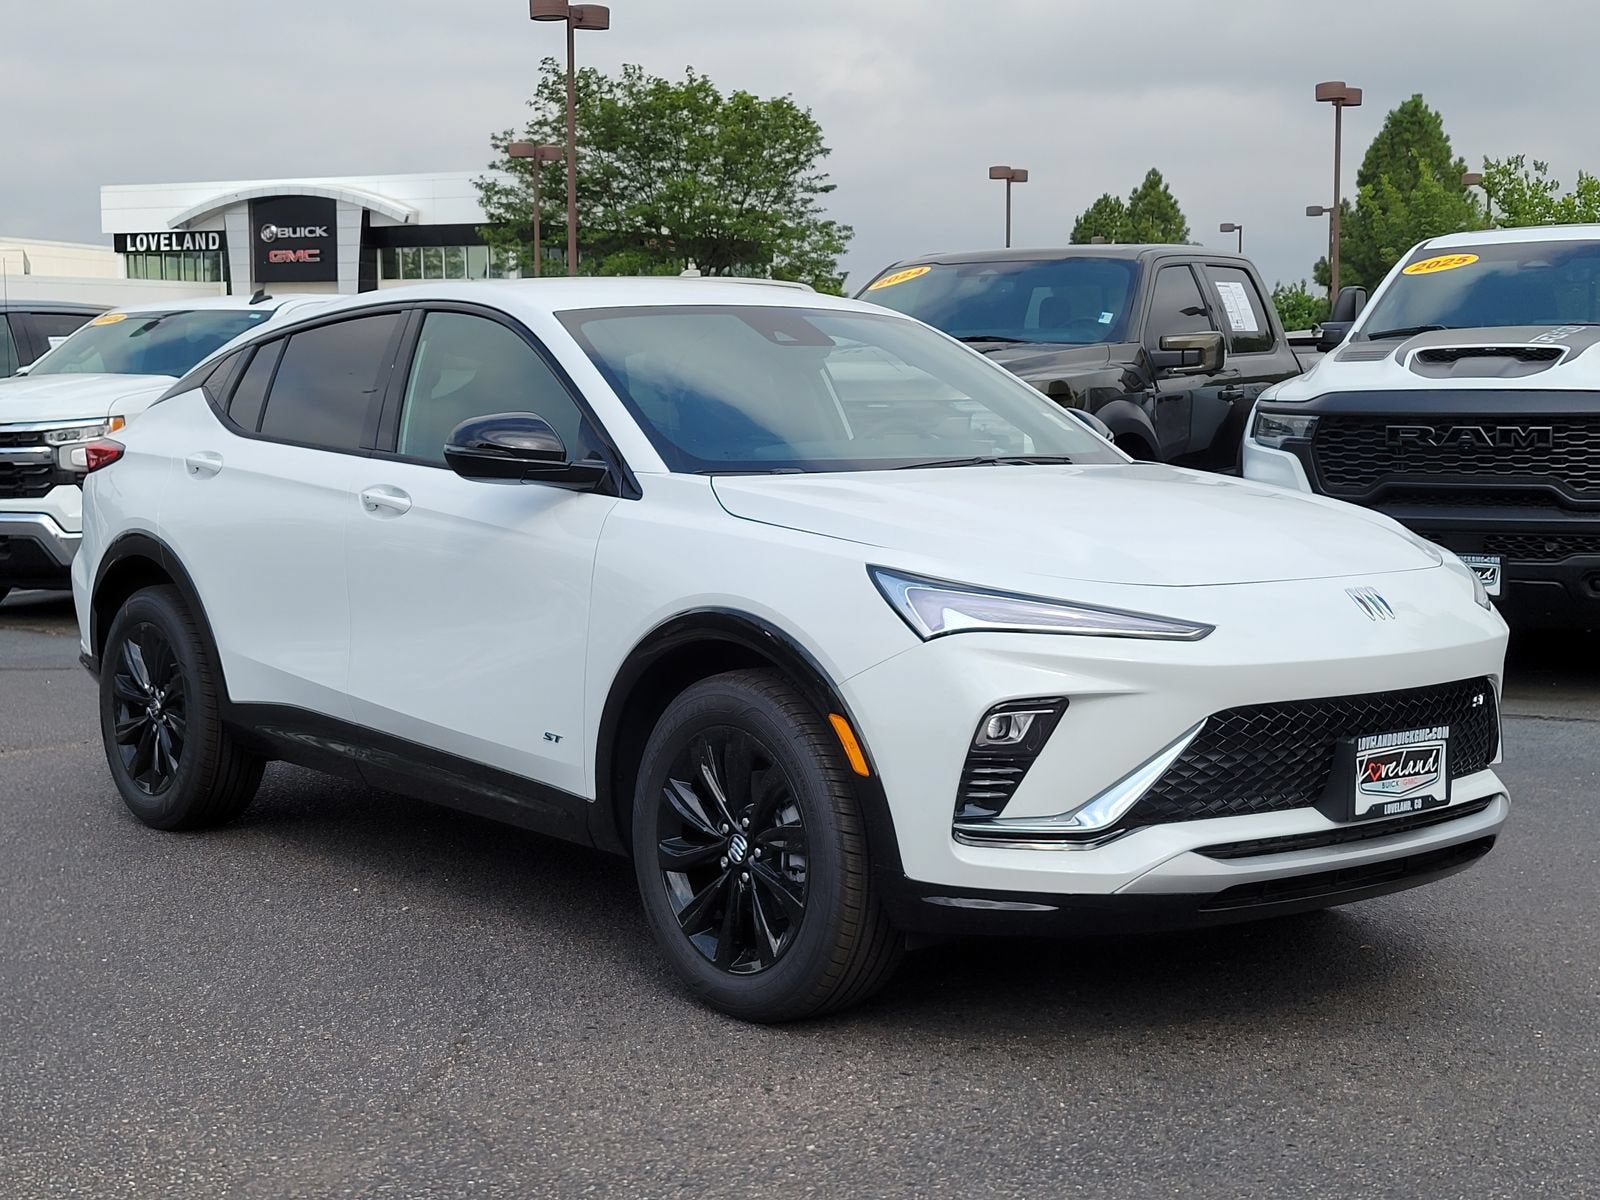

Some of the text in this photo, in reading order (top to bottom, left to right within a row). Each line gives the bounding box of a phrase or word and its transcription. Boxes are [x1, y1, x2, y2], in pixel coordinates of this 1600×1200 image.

[277, 226, 329, 238] BUICK
[126, 232, 219, 252] LOVELAND
[268, 249, 321, 263] GMC
[1410, 255, 1472, 274] 2025
[1385, 424, 1553, 447] RAM
[543, 731, 563, 743] ST
[1358, 726, 1449, 751] LOVELANDBUICKGMC.COM
[1359, 749, 1438, 782] Loveland
[1381, 777, 1419, 789] BUICK GMC
[1414, 798, 1422, 809] CO
